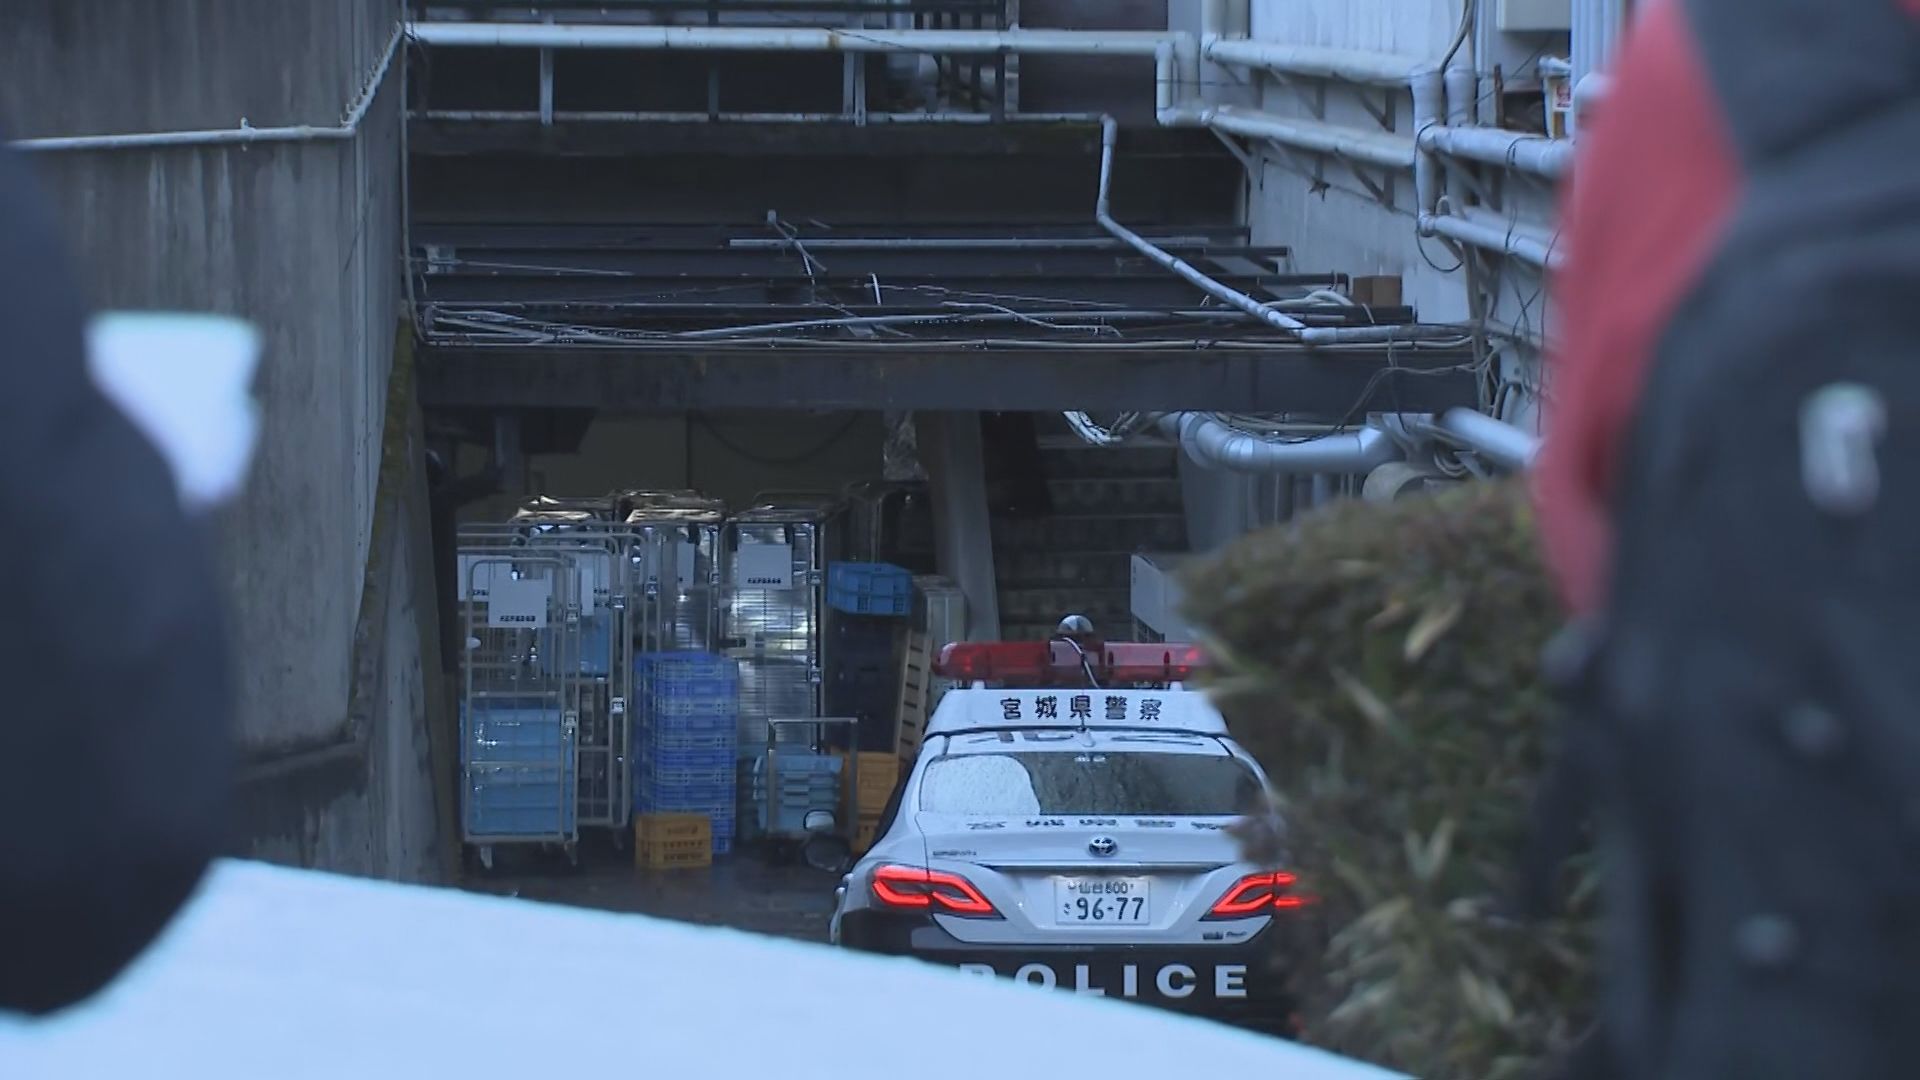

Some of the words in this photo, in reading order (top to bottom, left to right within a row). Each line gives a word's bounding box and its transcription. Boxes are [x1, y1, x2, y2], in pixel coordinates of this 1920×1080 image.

[1000, 695, 1162, 721] 宮城県警察
[1076, 897, 1144, 920] 96-77
